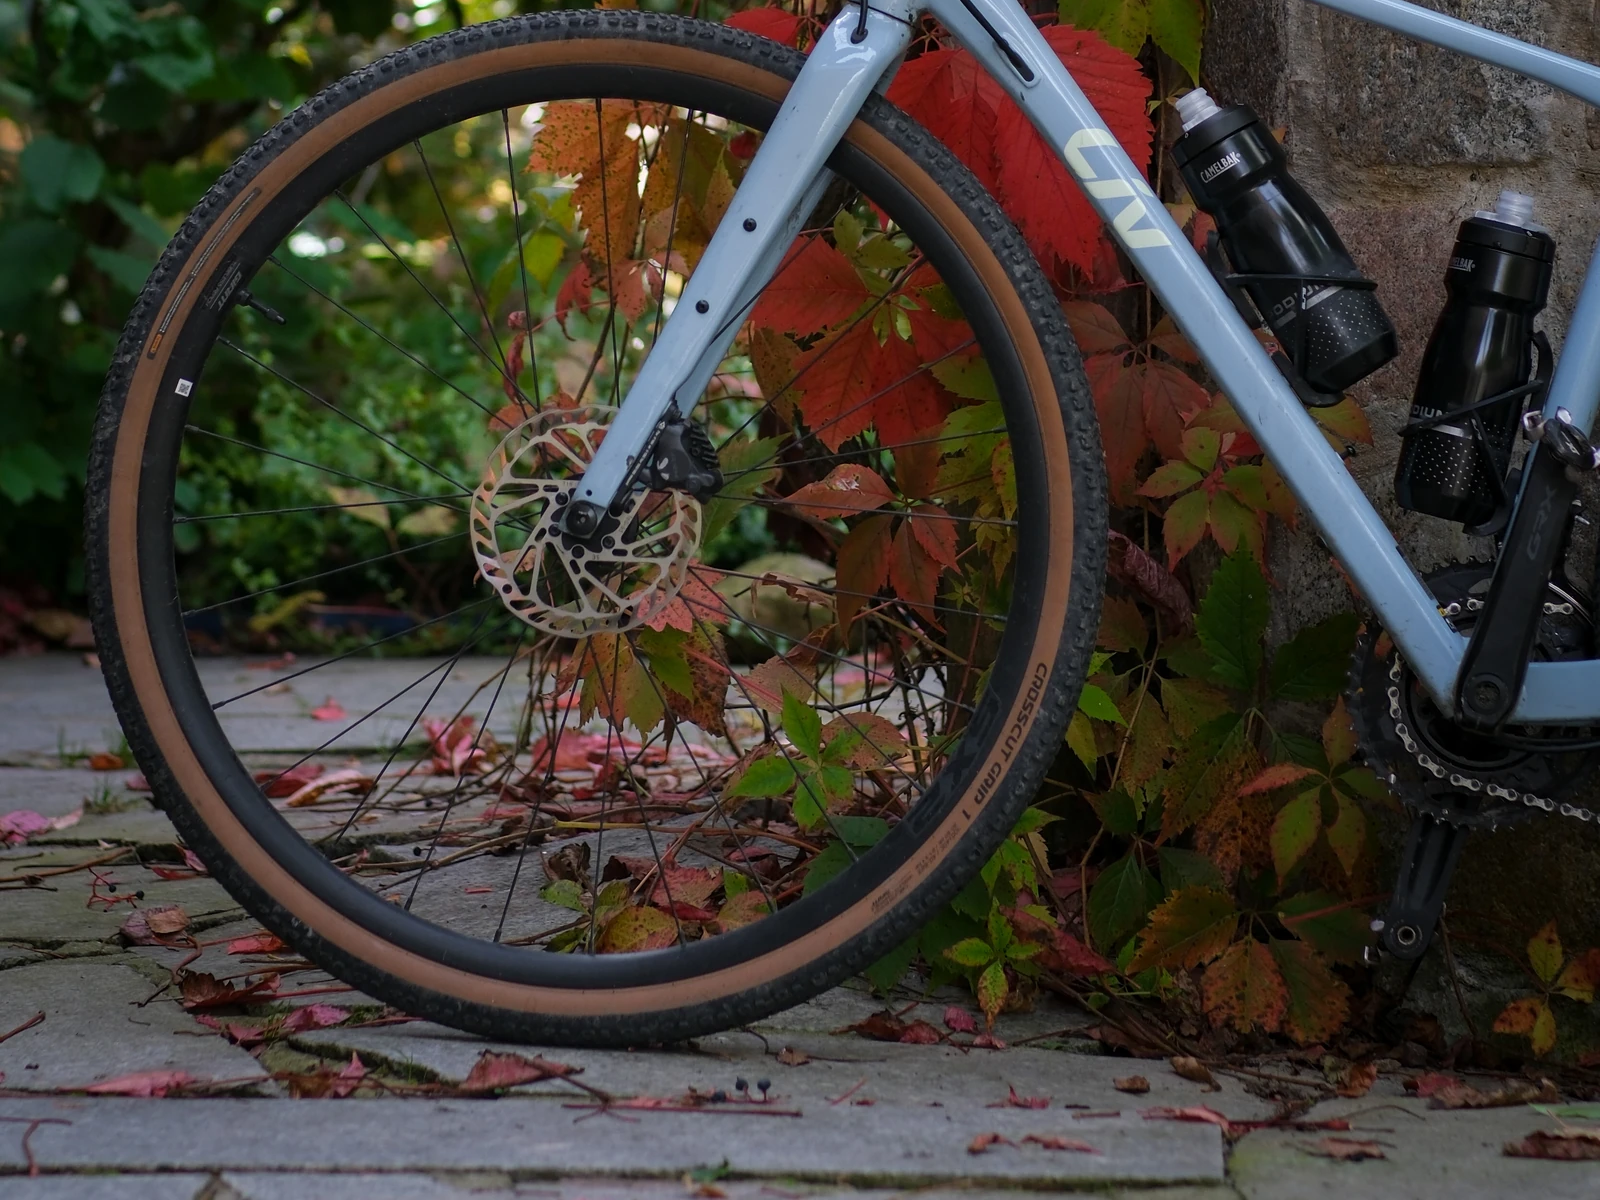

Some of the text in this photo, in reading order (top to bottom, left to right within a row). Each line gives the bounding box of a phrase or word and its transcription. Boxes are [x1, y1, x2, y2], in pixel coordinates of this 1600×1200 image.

[1200, 151, 1240, 183] CAMELBAK
[1449, 256, 1472, 272] ELBAK
[217, 270, 242, 311] GIANT
[1002, 662, 1047, 761] CROSSCUT
[974, 761, 1003, 805] GRIP
